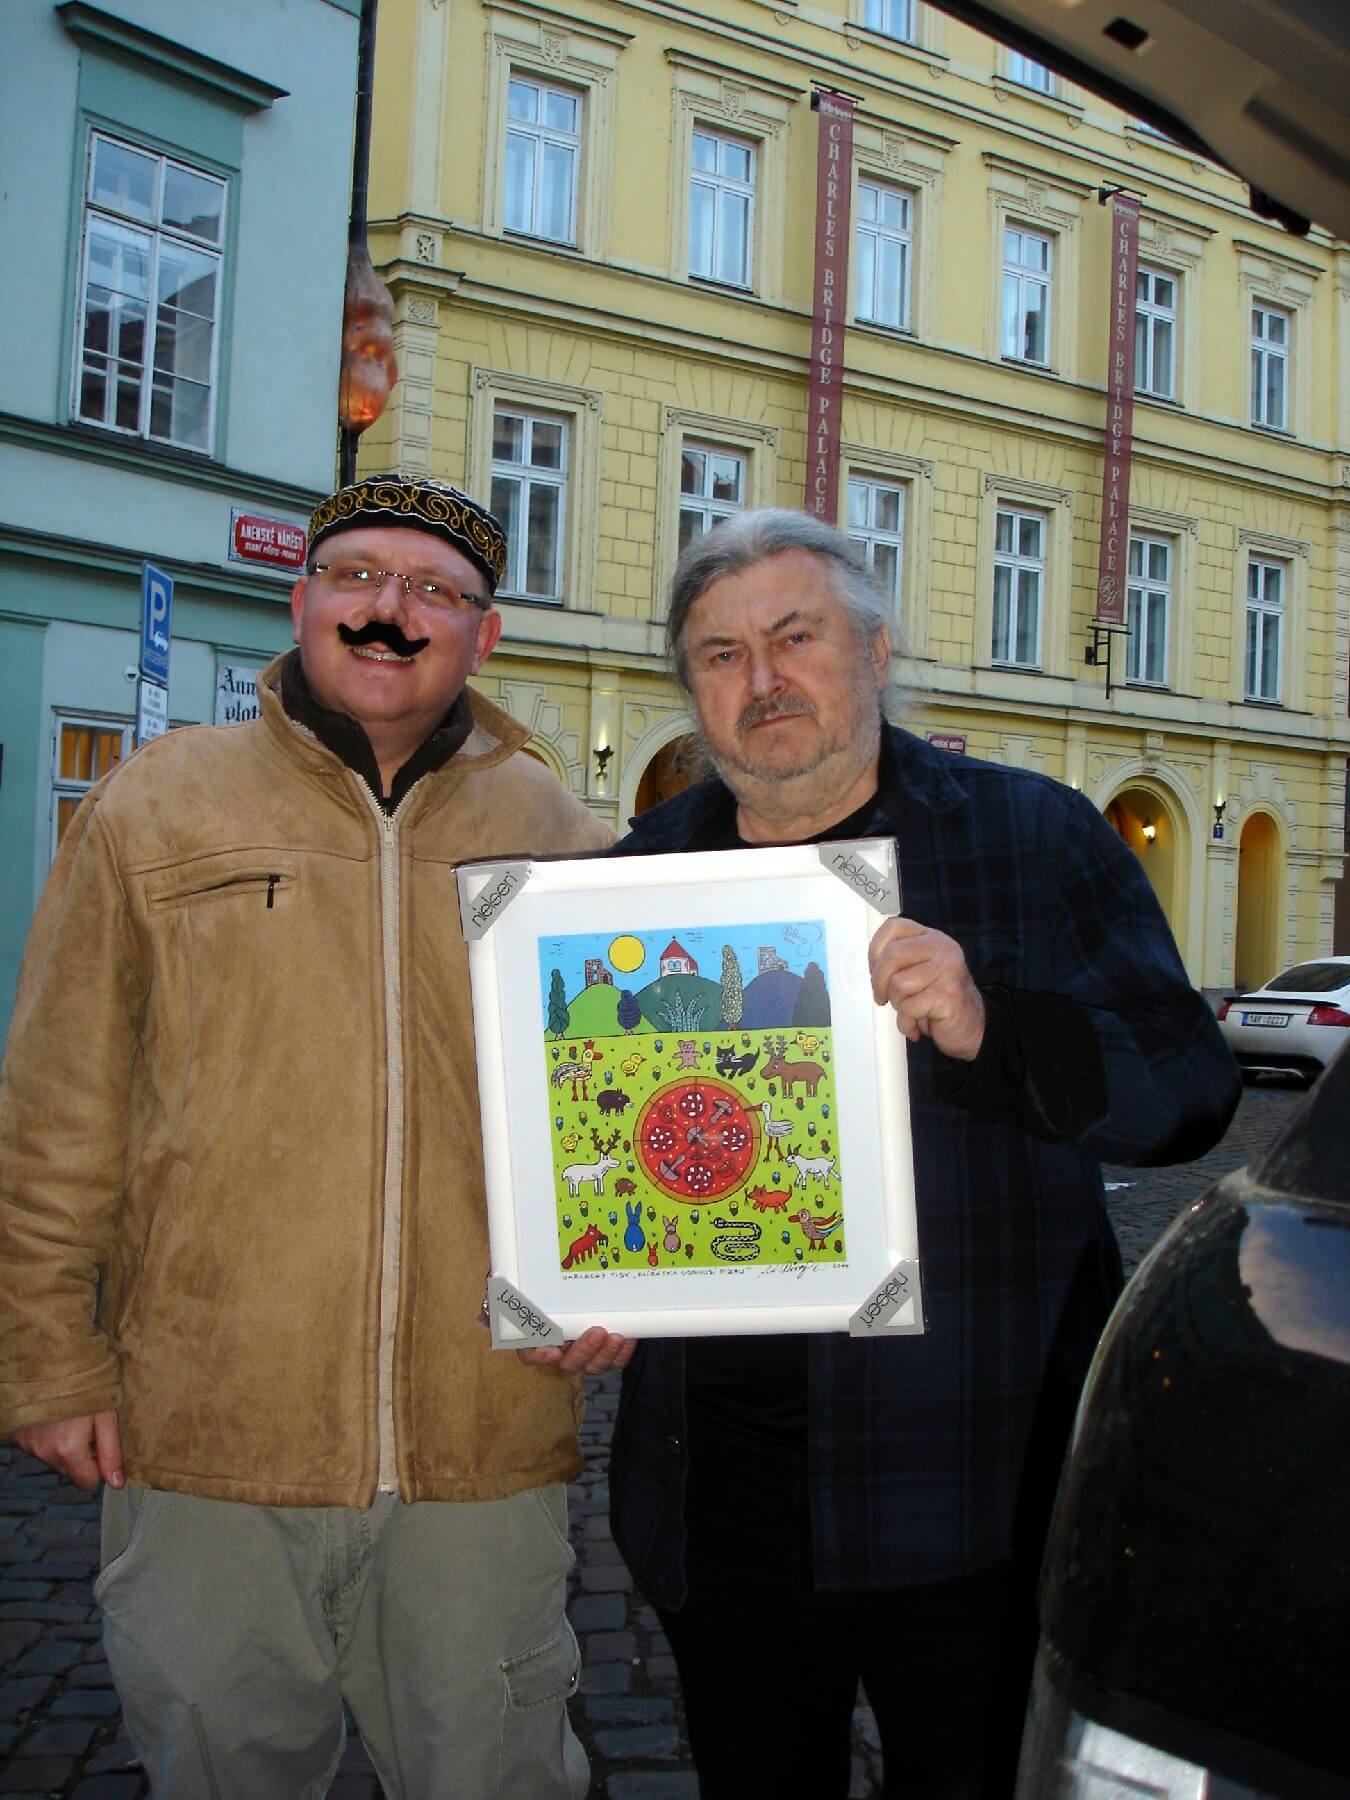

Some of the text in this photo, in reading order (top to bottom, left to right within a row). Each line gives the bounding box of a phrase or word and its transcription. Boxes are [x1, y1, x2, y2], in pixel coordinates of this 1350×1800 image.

[814, 124, 841, 514] CHARLES BRIDGE PALACE
[1116, 223, 1130, 341] CHARLES
[1111, 352, 1125, 456] BRIDGE
[1107, 466, 1120, 571] PALACE
[151, 580, 166, 640] P
